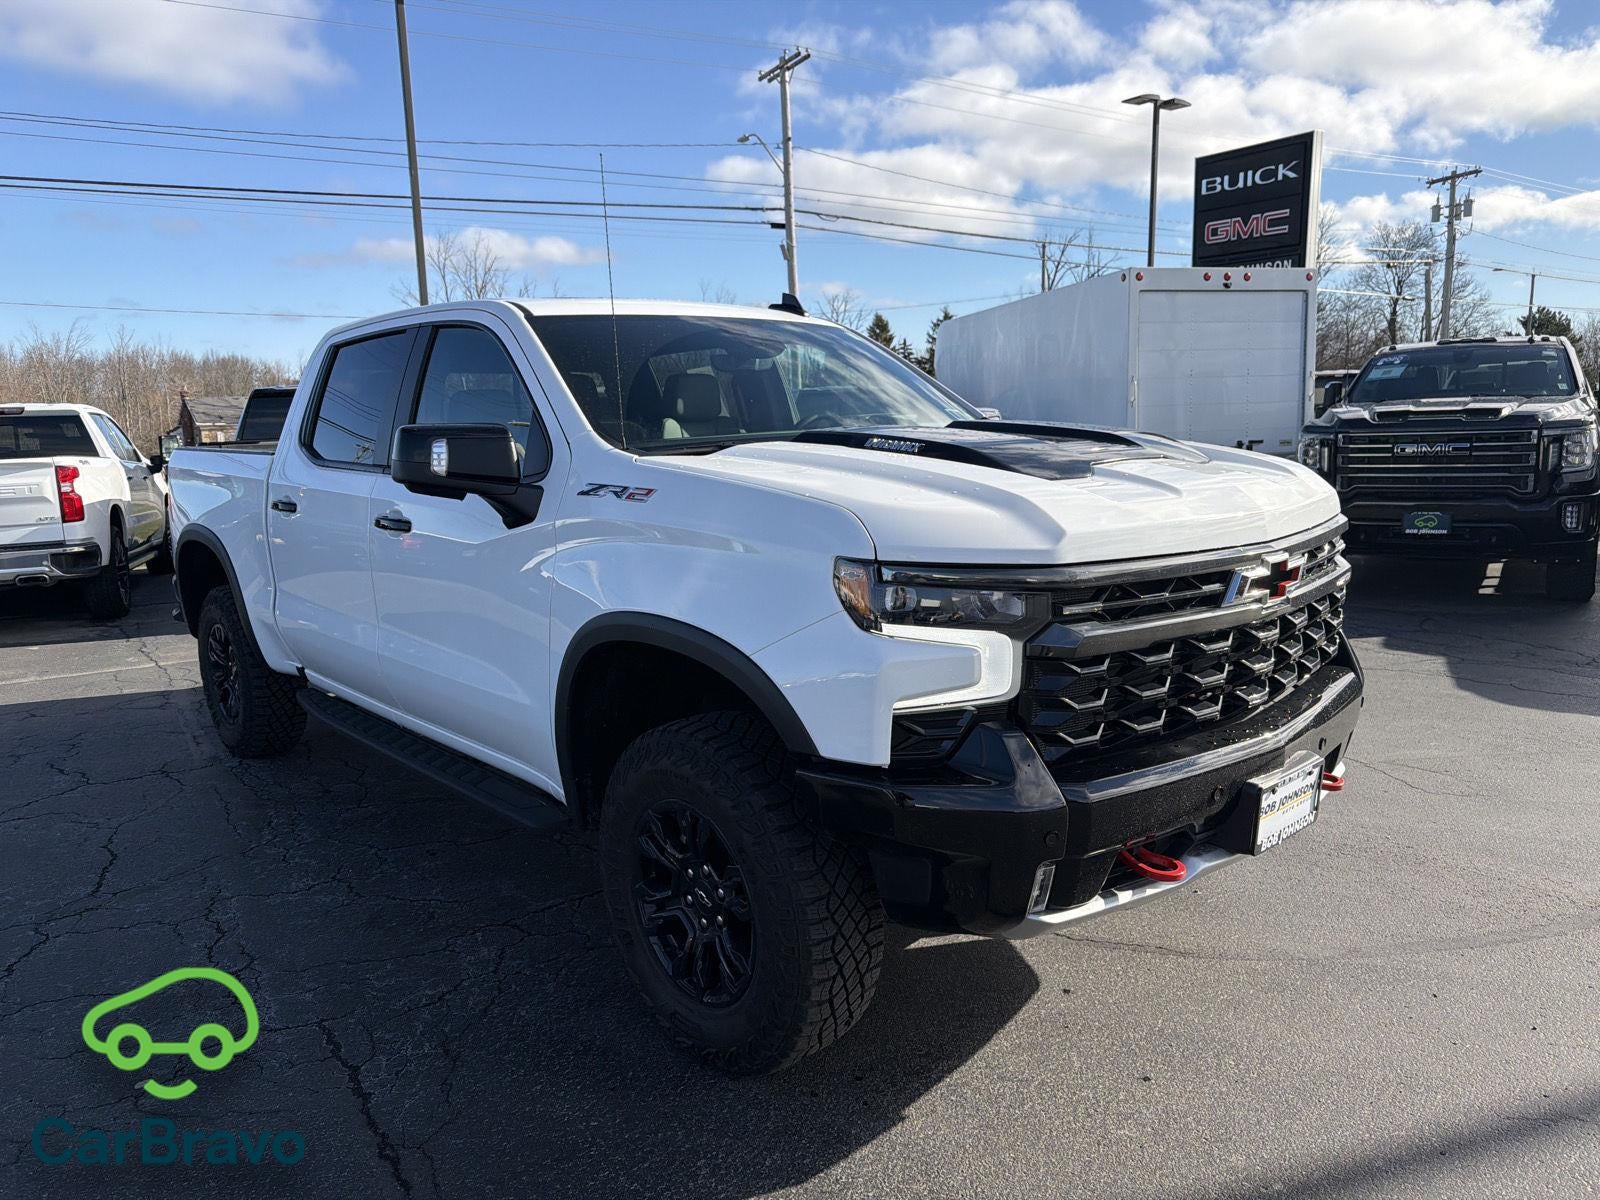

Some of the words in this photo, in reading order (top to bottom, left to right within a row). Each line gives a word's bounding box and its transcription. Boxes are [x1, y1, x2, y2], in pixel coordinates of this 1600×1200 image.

[1201, 160, 1298, 195] BUICK
[1204, 209, 1290, 244] GMC
[1393, 443, 1470, 456] GMC
[577, 483, 657, 503] ZR2
[1277, 780, 1316, 812] JOHNSON
[1260, 832, 1280, 853] BOB
[1279, 811, 1318, 845] JOHNSON
